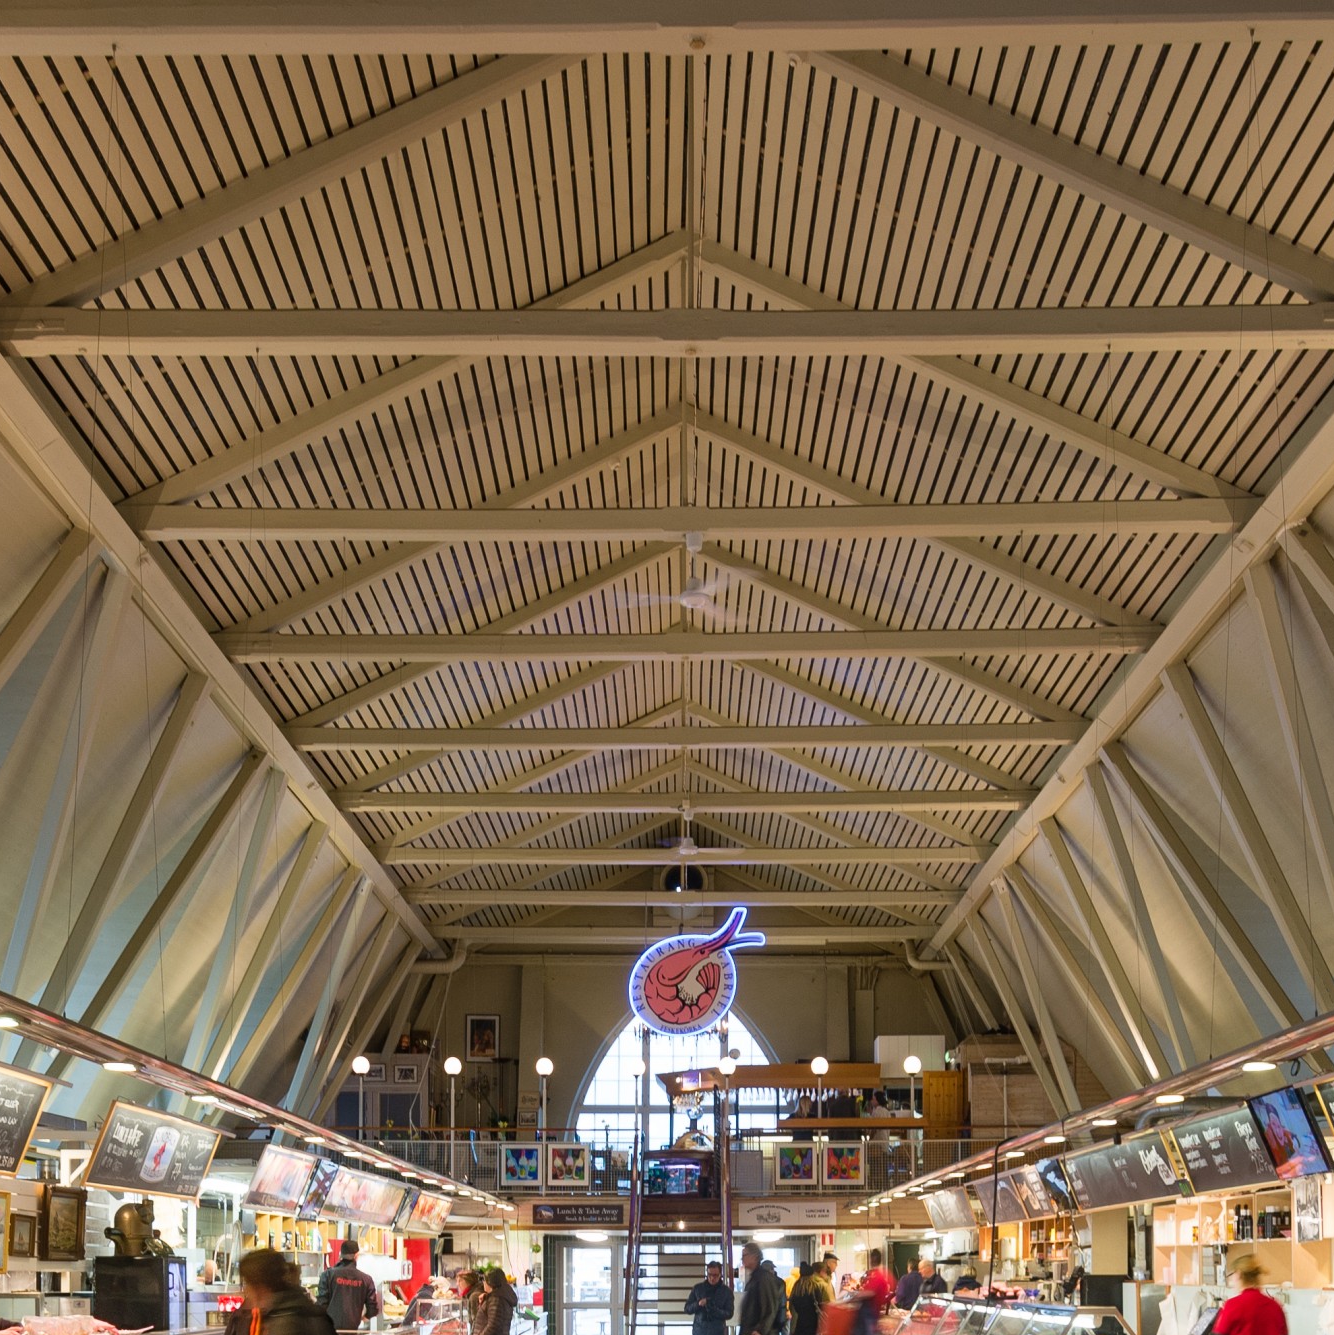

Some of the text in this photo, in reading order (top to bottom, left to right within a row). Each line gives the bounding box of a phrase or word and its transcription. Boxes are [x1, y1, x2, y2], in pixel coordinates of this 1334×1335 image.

[632, 938, 696, 1013] RESTAURANG
[556, 1207, 619, 1217] Lunch & Take Away
